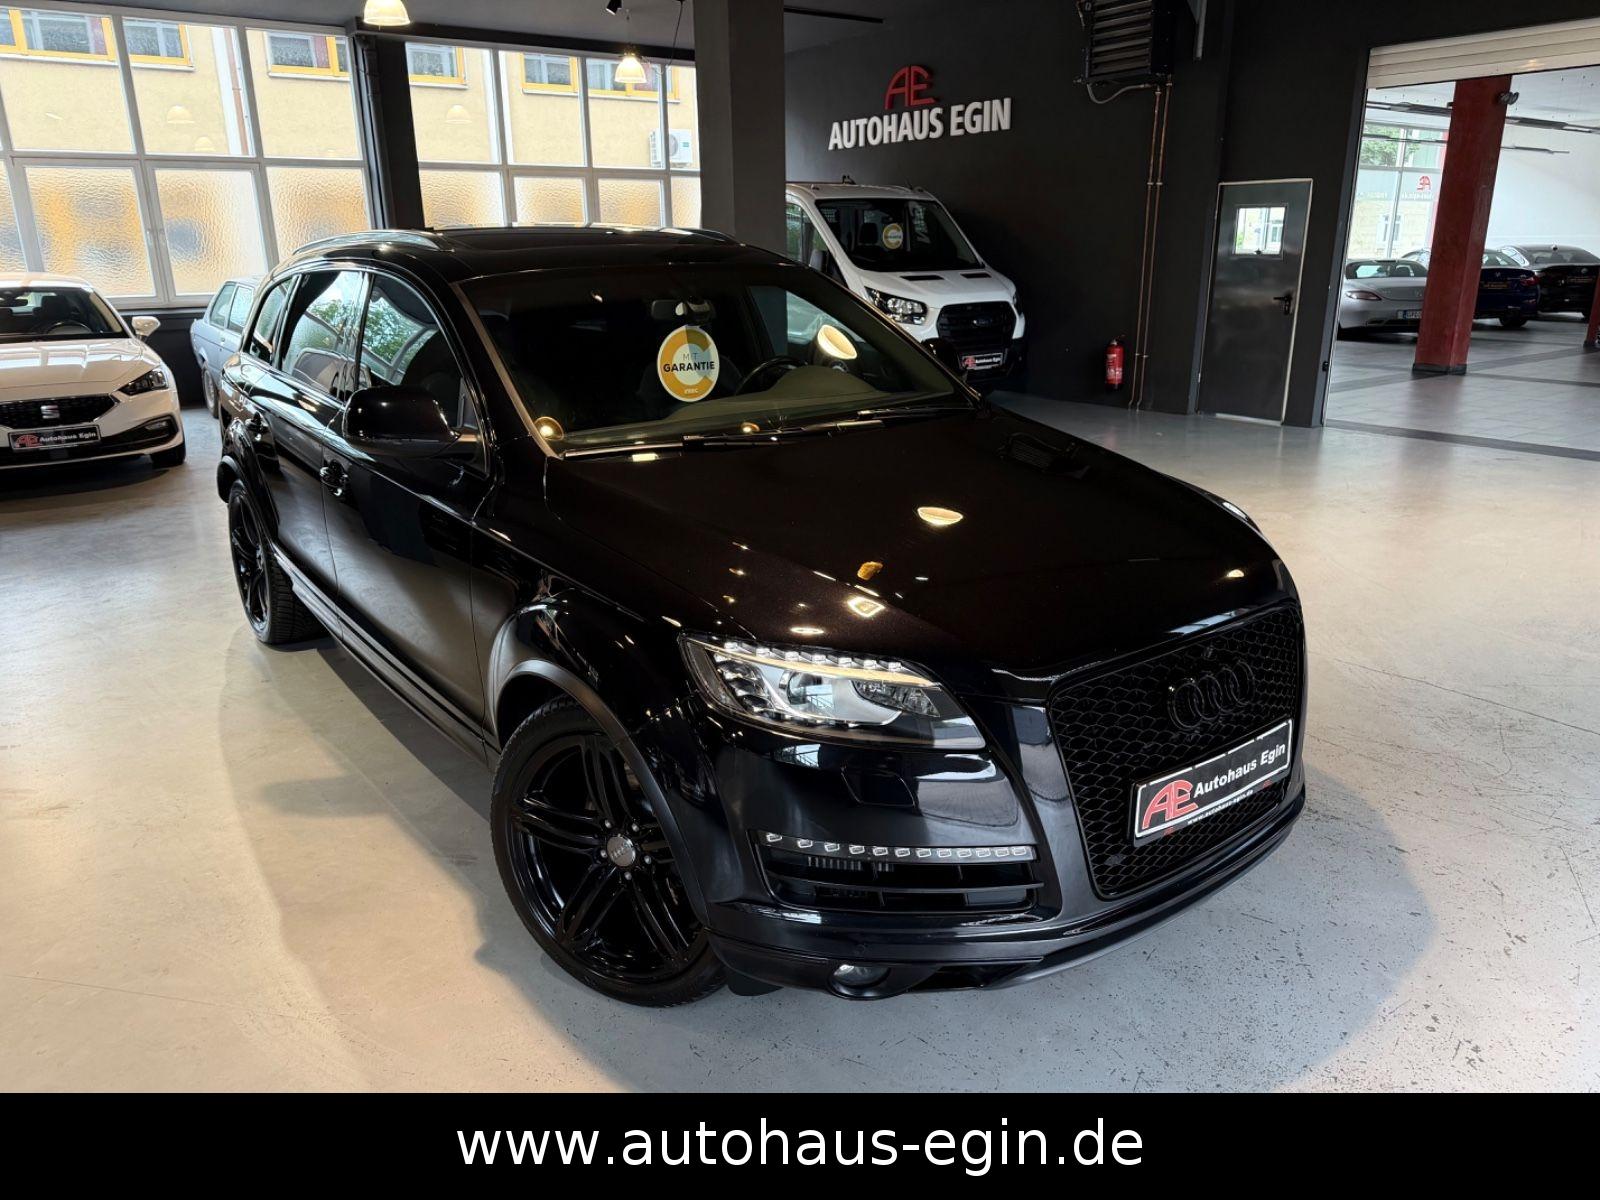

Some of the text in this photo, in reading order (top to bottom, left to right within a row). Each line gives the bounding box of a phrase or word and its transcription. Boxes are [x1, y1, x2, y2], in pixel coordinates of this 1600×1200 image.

[885, 65, 936, 110] AE
[828, 97, 1012, 150] AUTOHAUS EGIN
[663, 361, 715, 373] GARANTIE
[40, 434, 78, 442] Autohaus
[79, 432, 96, 440] Egin
[1141, 742, 1286, 830] AE Autohaus Egin
